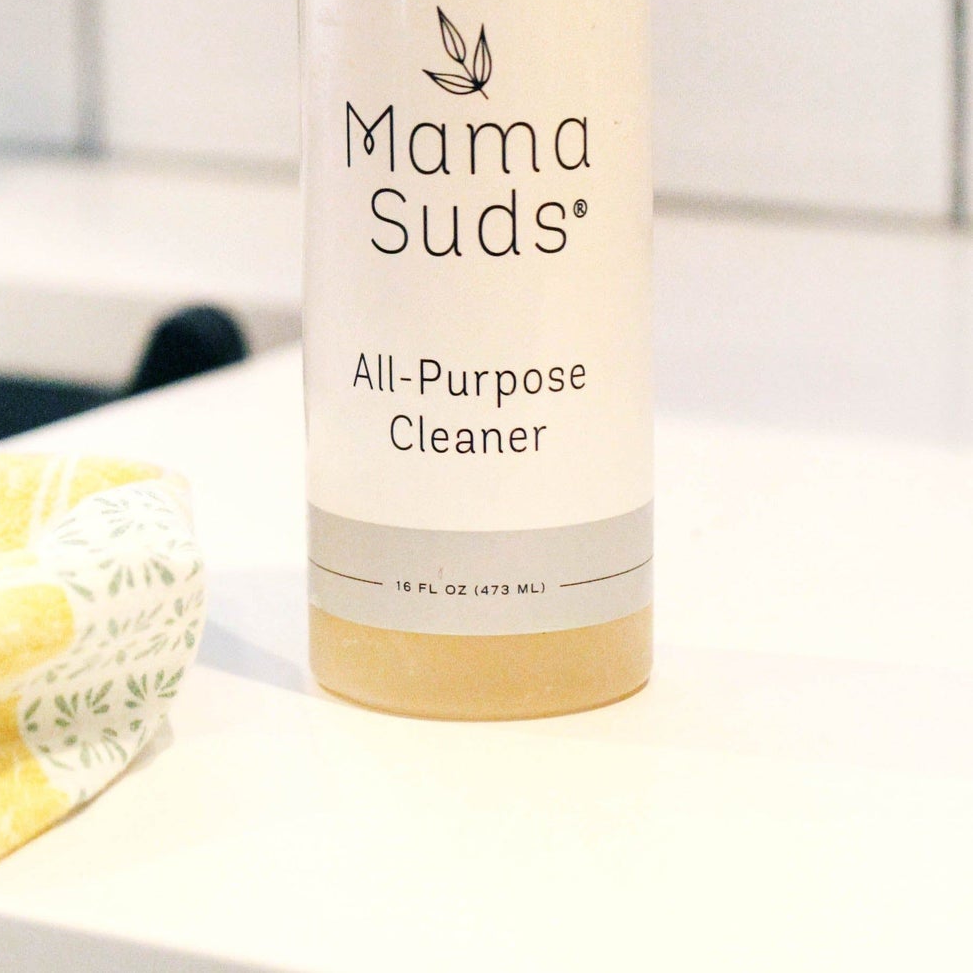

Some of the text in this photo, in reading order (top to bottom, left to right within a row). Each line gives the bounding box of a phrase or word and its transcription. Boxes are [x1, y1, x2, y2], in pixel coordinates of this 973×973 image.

[346, 100, 590, 175] Mama
[353, 352, 587, 408] All-Purpose
[390, 414, 547, 454] Cleaner
[396, 580, 546, 597] 16 FL OZ (473 ML)
